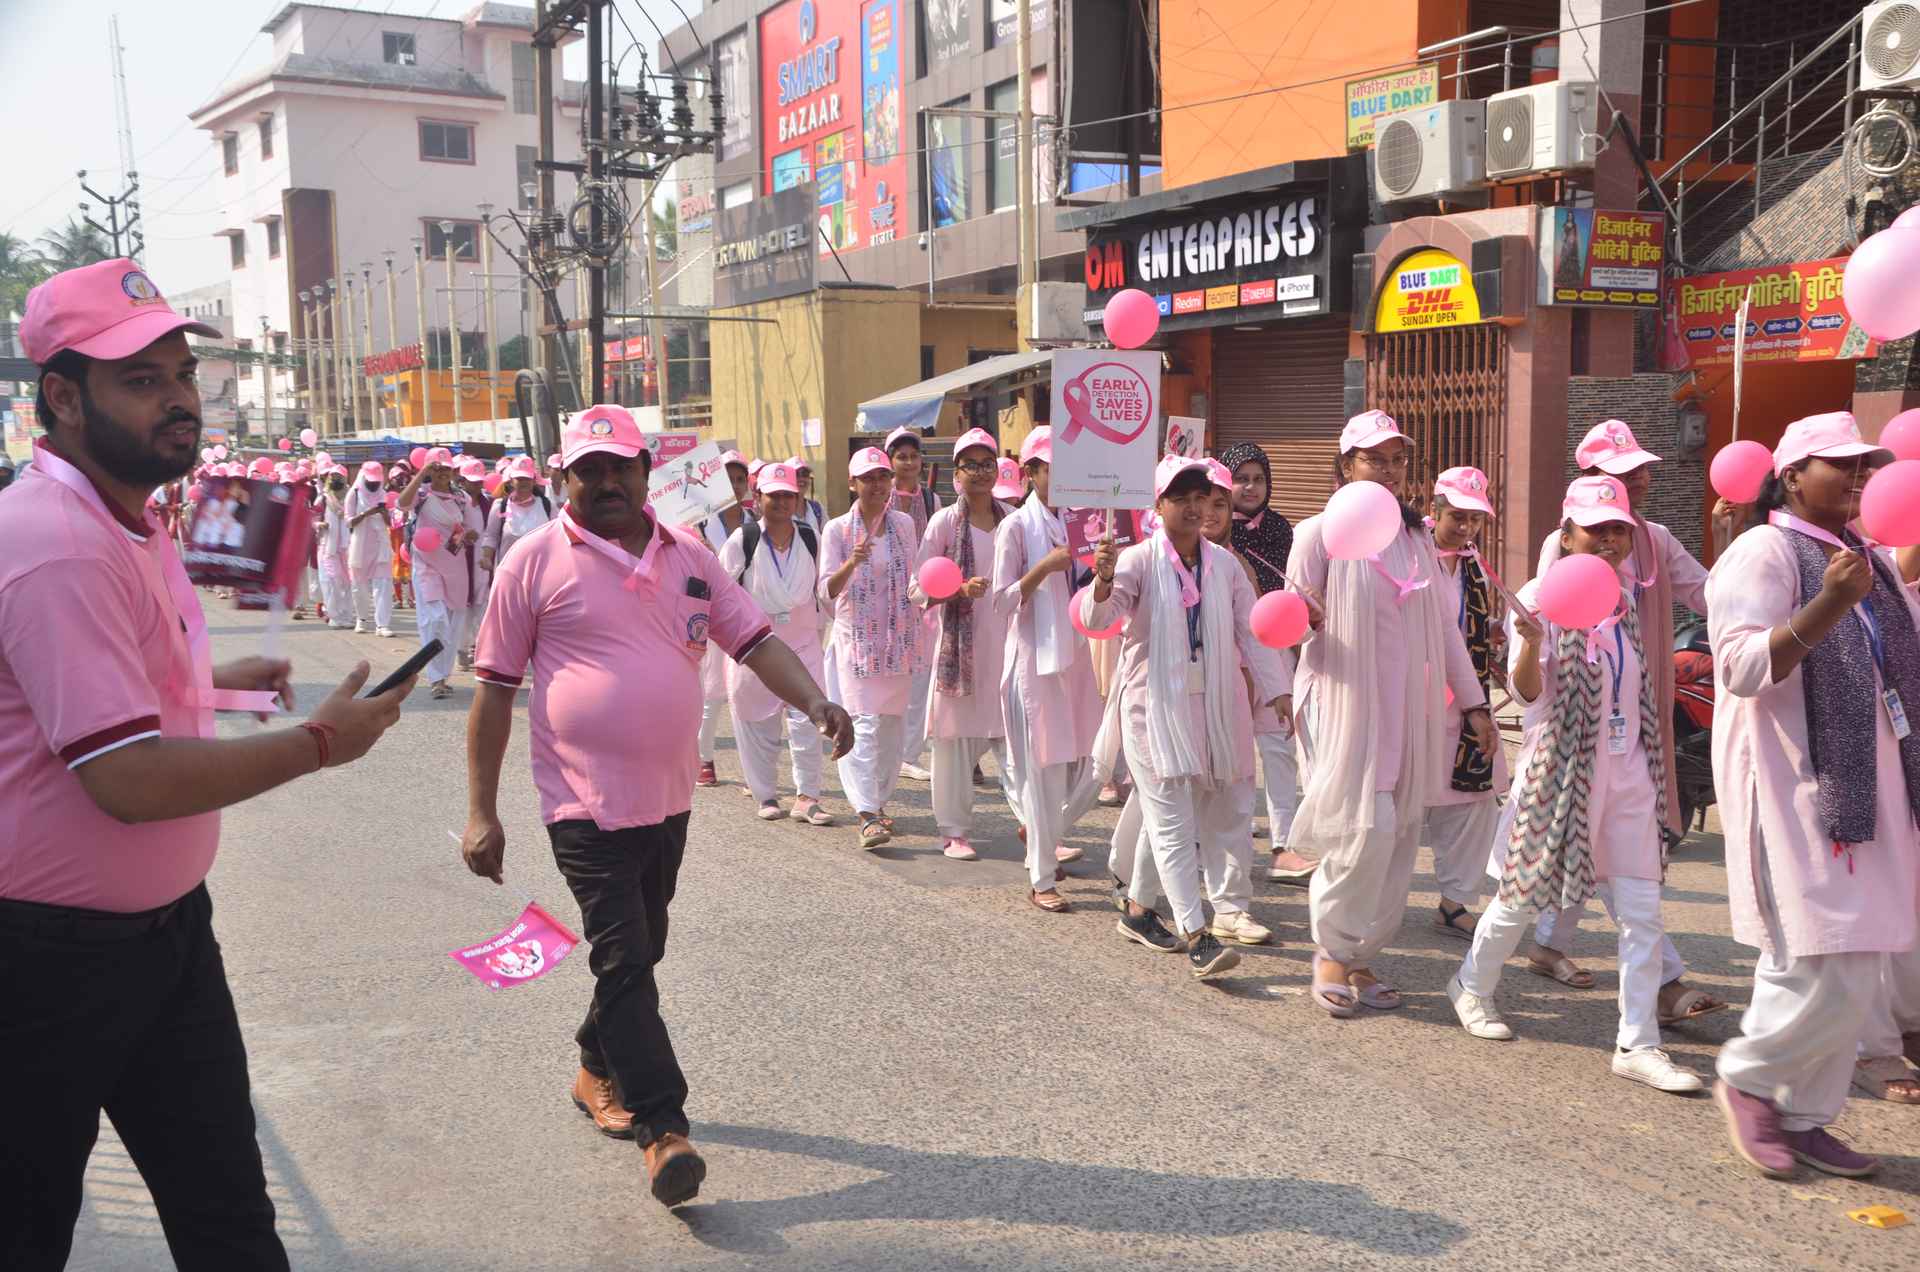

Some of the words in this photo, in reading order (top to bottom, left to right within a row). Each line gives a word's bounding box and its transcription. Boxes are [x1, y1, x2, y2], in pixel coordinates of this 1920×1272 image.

[778, 35, 841, 106] SMART
[1350, 95, 1386, 118] BLUE
[1391, 84, 1432, 109] DART
[778, 94, 840, 144] BAZAAR
[1597, 216, 1652, 238] डिजाईनर
[1084, 239, 1126, 291] OM
[1137, 197, 1316, 282] ENTERPRISES
[1592, 239, 1630, 260] मोहिनी
[1631, 241, 1662, 267] बुटिक
[1286, 281, 1311, 293] iPhone
[1400, 271, 1427, 290] BLUE
[1429, 267, 1458, 286] DART
[1175, 295, 1202, 310] Redmi
[1407, 287, 1453, 314] DHL
[1681, 279, 1748, 316] डिजाईनर
[1749, 271, 1802, 307] मोहिनी
[1401, 313, 1433, 326] SUNDAY
[1436, 311, 1457, 323] OPEN
[1091, 390, 1139, 398] DETECTION
[1092, 379, 1138, 390] EARLY
[1096, 398, 1143, 409] SAVES
[1101, 410, 1142, 421] LIVES
